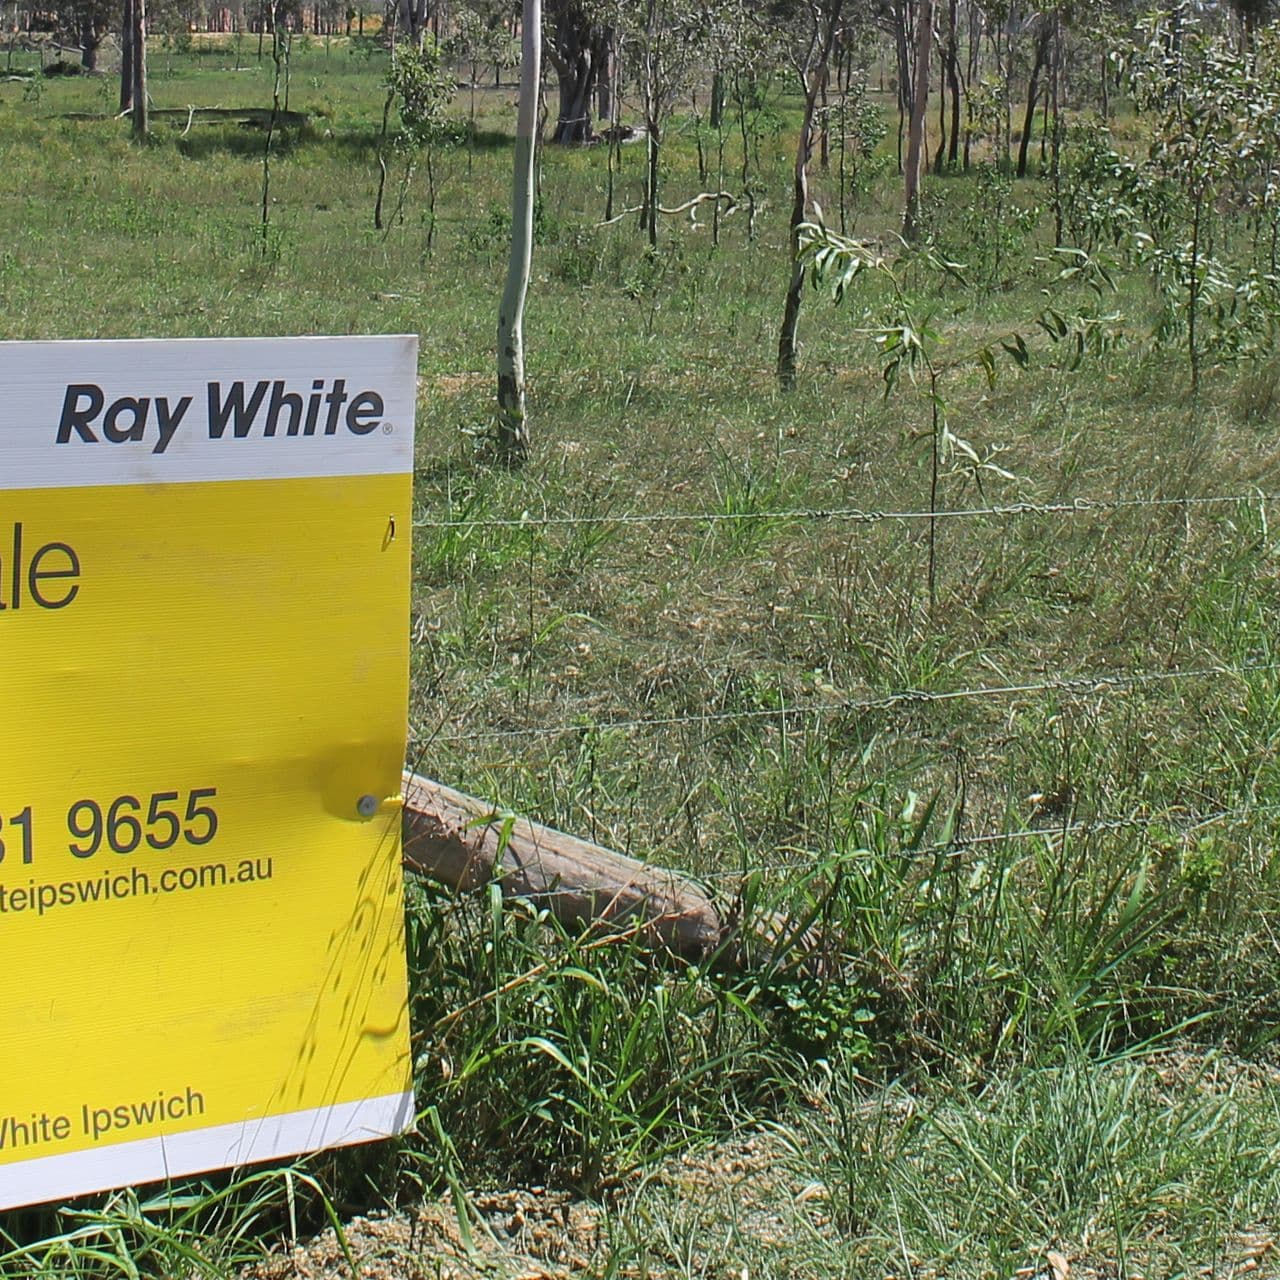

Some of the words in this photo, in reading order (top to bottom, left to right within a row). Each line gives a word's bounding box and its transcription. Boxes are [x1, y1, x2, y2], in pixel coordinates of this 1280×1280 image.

[55, 383, 193, 454] Ray
[207, 378, 385, 440] White
[67, 787, 219, 859] 9655
[82, 1086, 205, 1140] Ipswich
